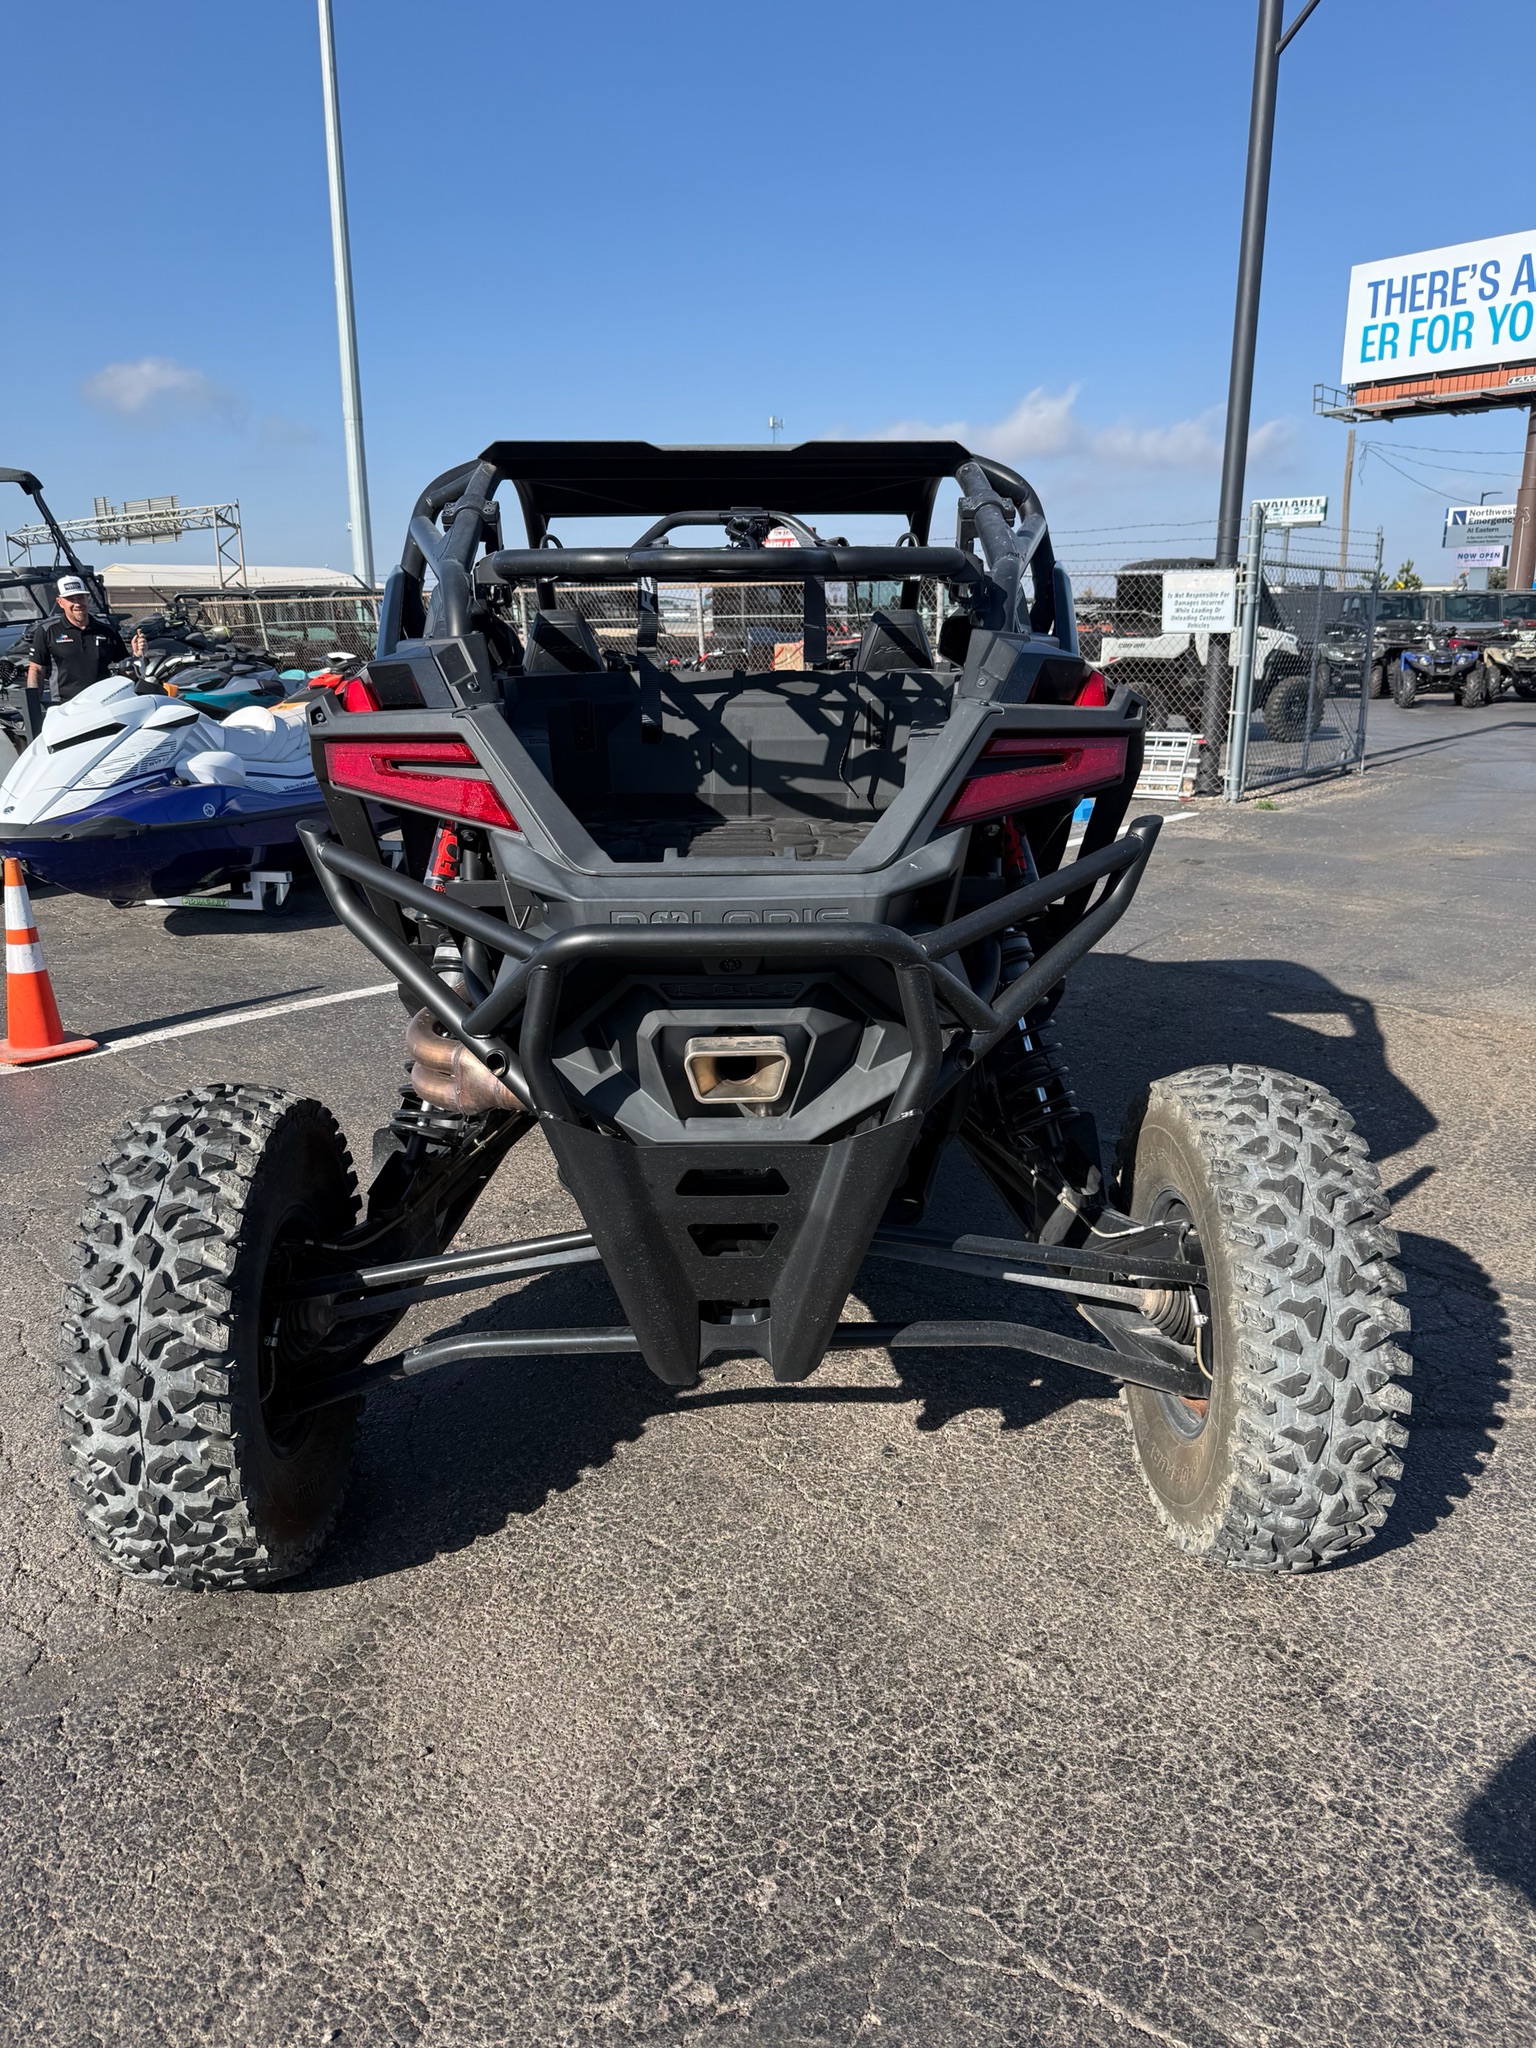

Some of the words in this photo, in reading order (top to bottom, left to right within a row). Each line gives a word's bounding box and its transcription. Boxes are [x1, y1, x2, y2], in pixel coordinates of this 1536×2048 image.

[1367, 260, 1501, 319] THERE'S
[1360, 322, 1400, 363] ER
[1409, 310, 1475, 357] FOR
[1263, 498, 1323, 509] VAILABLE
[1469, 508, 1517, 516] Northwest
[1174, 599, 1199, 607] Damages
